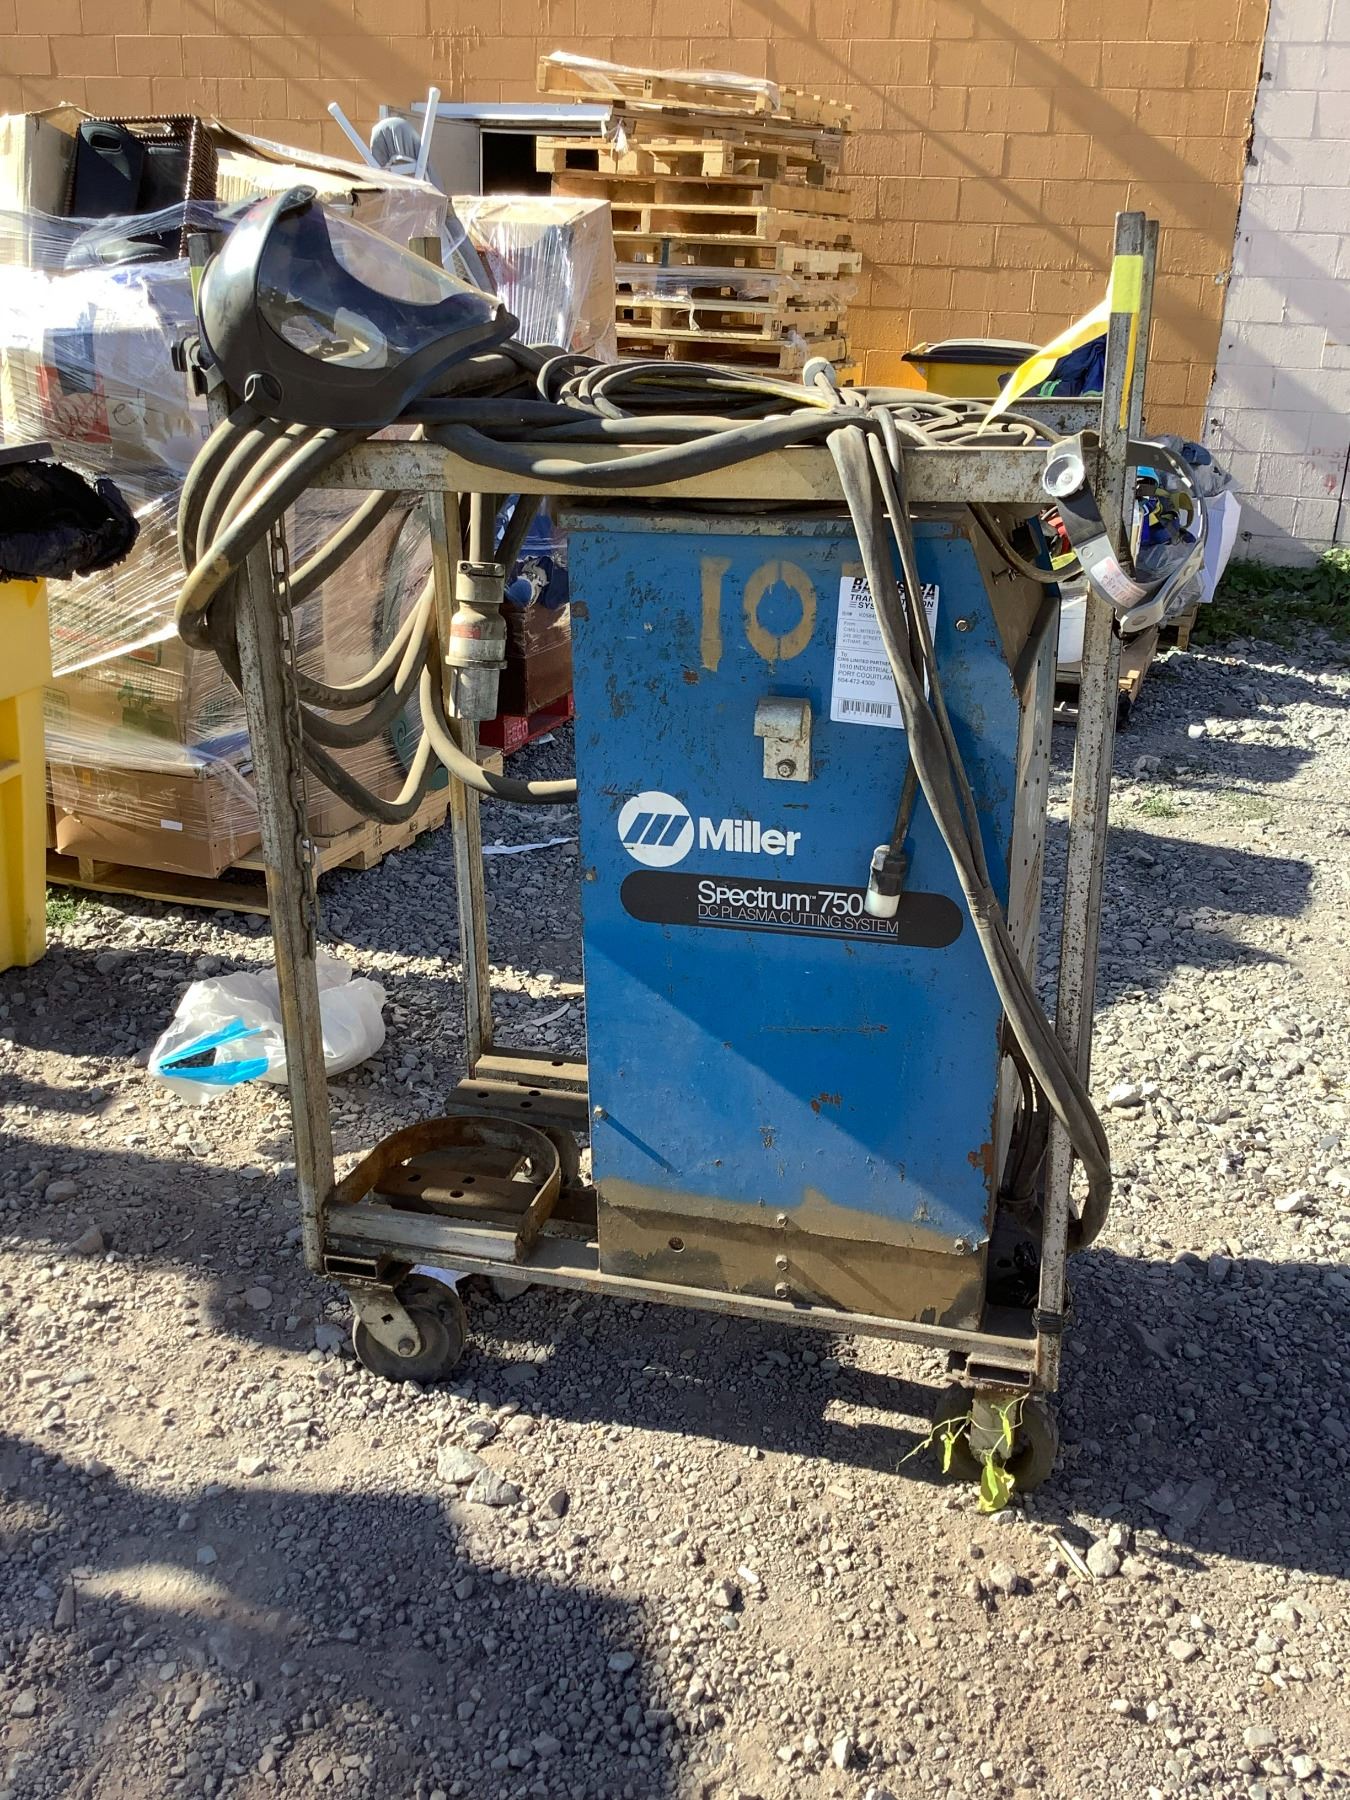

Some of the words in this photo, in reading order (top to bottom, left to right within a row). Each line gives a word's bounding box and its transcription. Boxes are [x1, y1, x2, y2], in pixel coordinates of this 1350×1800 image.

[838, 669, 855, 677] PORT
[856, 671, 893, 680] COQUITLAM
[853, 664, 889, 674] INDUSTRIAL
[699, 816, 801, 856] Miller
[818, 891, 864, 916] 750
[698, 903, 720, 918] DC
[722, 907, 778, 923] PLASMA
[780, 912, 841, 929] CUTTING
[844, 916, 899, 934] SYSTEM
